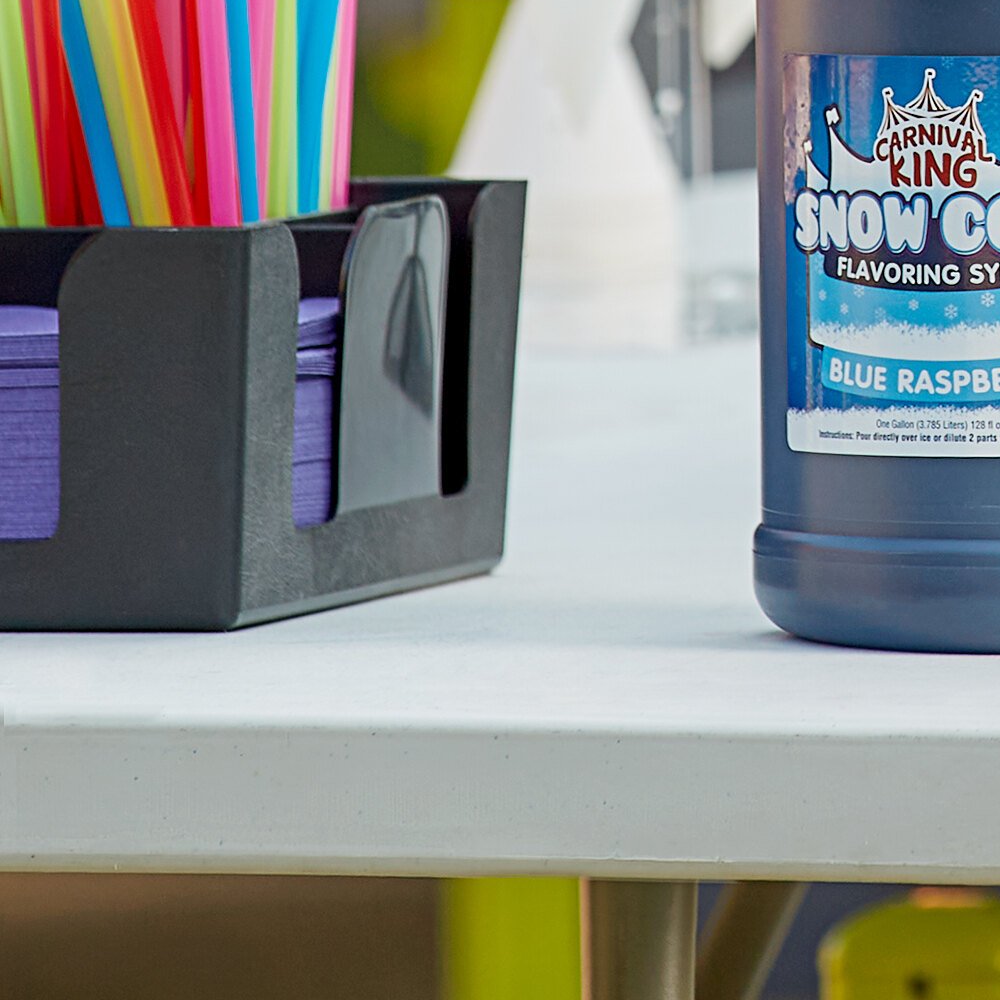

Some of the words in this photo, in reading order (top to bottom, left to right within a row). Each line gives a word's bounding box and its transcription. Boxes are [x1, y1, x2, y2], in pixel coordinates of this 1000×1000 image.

[876, 124, 993, 162] CARNIVAL
[890, 150, 977, 188] KING
[794, 193, 929, 255] SNOW
[837, 257, 961, 286] FLAVORING
[829, 358, 887, 392] BLUE
[819, 430, 853, 440] Instructions:
[856, 432, 871, 440] Pour
[873, 433, 899, 442] directly
[921, 434, 931, 442] ice
[943, 434, 967, 443] dilute
[969, 434, 974, 442] 2
[977, 434, 997, 443] parts
[876, 419, 889, 428] One
[891, 420, 914, 429] Gallon
[916, 420, 940, 430] (3.785
[943, 420, 968, 430] Liters)
[971, 421, 985, 429] 128
[988, 421, 992, 429] fl
